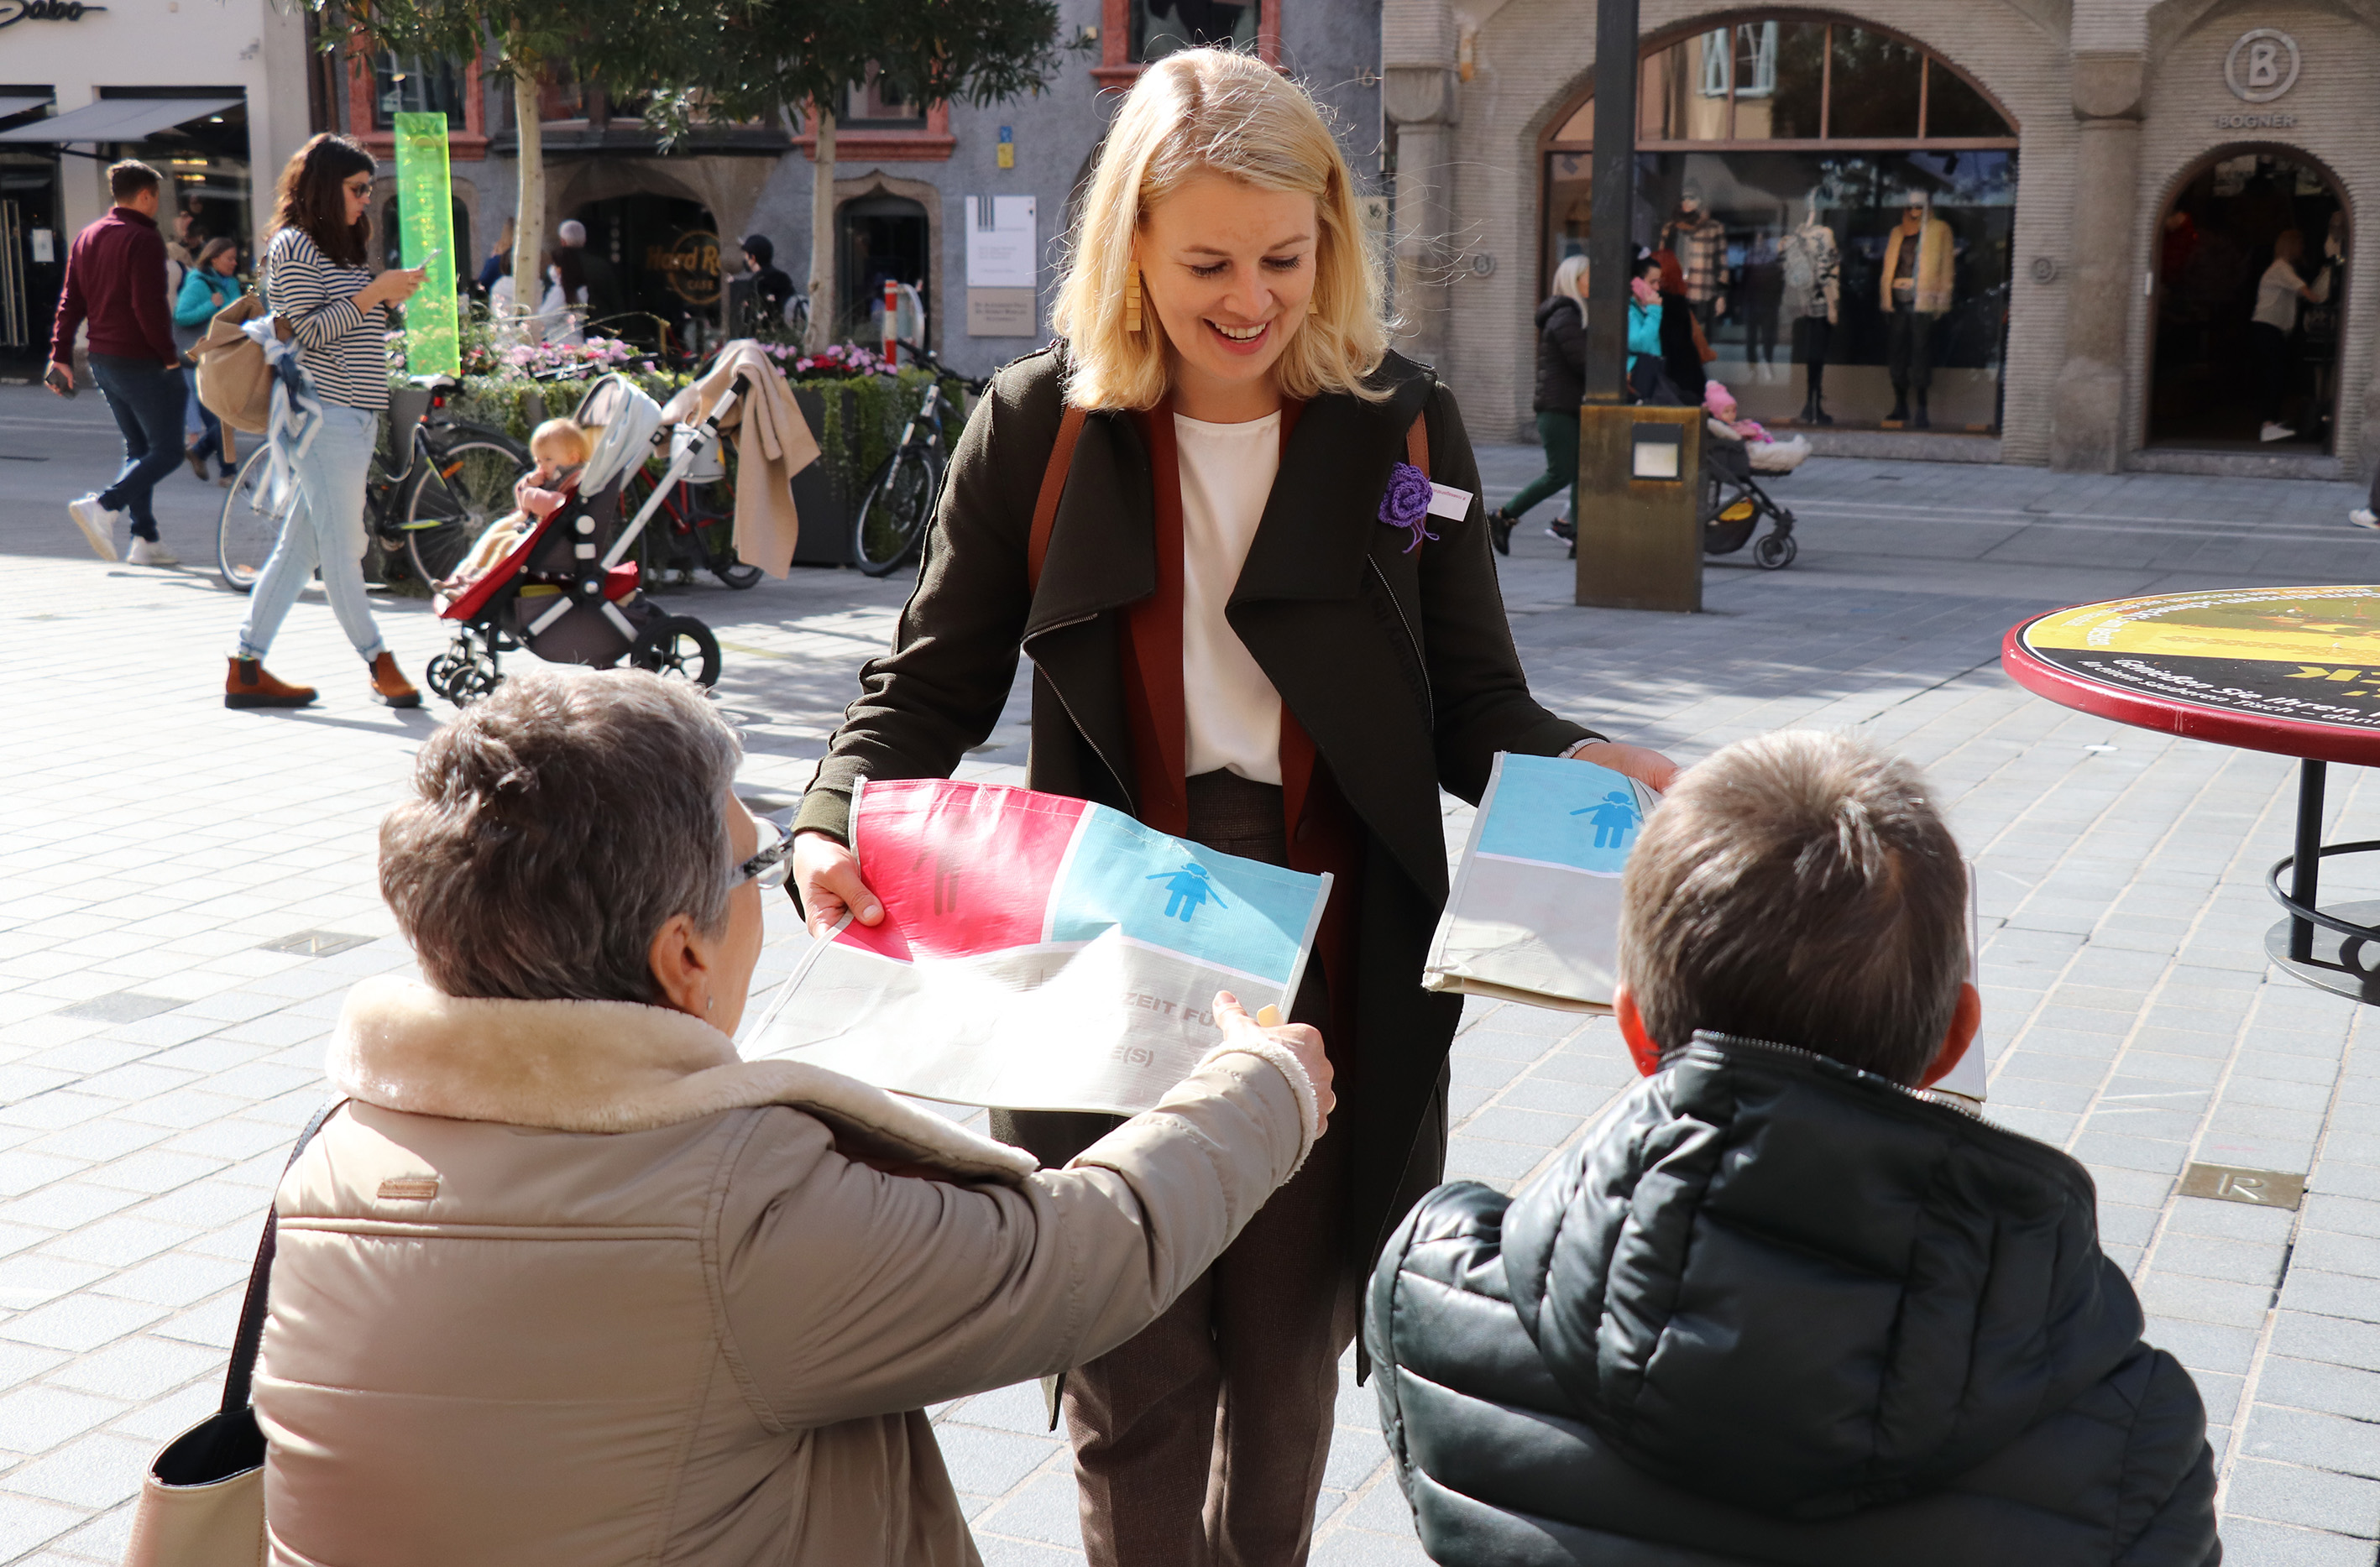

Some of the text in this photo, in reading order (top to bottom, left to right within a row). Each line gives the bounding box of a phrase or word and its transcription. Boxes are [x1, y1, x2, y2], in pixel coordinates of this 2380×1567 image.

[1353, 65, 1376, 88] 16
[2217, 116, 2295, 128] BOGNER
[646, 245, 698, 271] Hard
[2094, 666, 2143, 682] einem
[2137, 681, 2230, 703] sauberen
[2232, 699, 2294, 713] Tisch
[2112, 659, 2215, 689] Genießen
[2210, 687, 2263, 699] Sie
[2262, 697, 2361, 714] Ihren
[1122, 992, 1222, 1029] ZEIT FÜ
[2217, 1173, 2268, 1201] R
